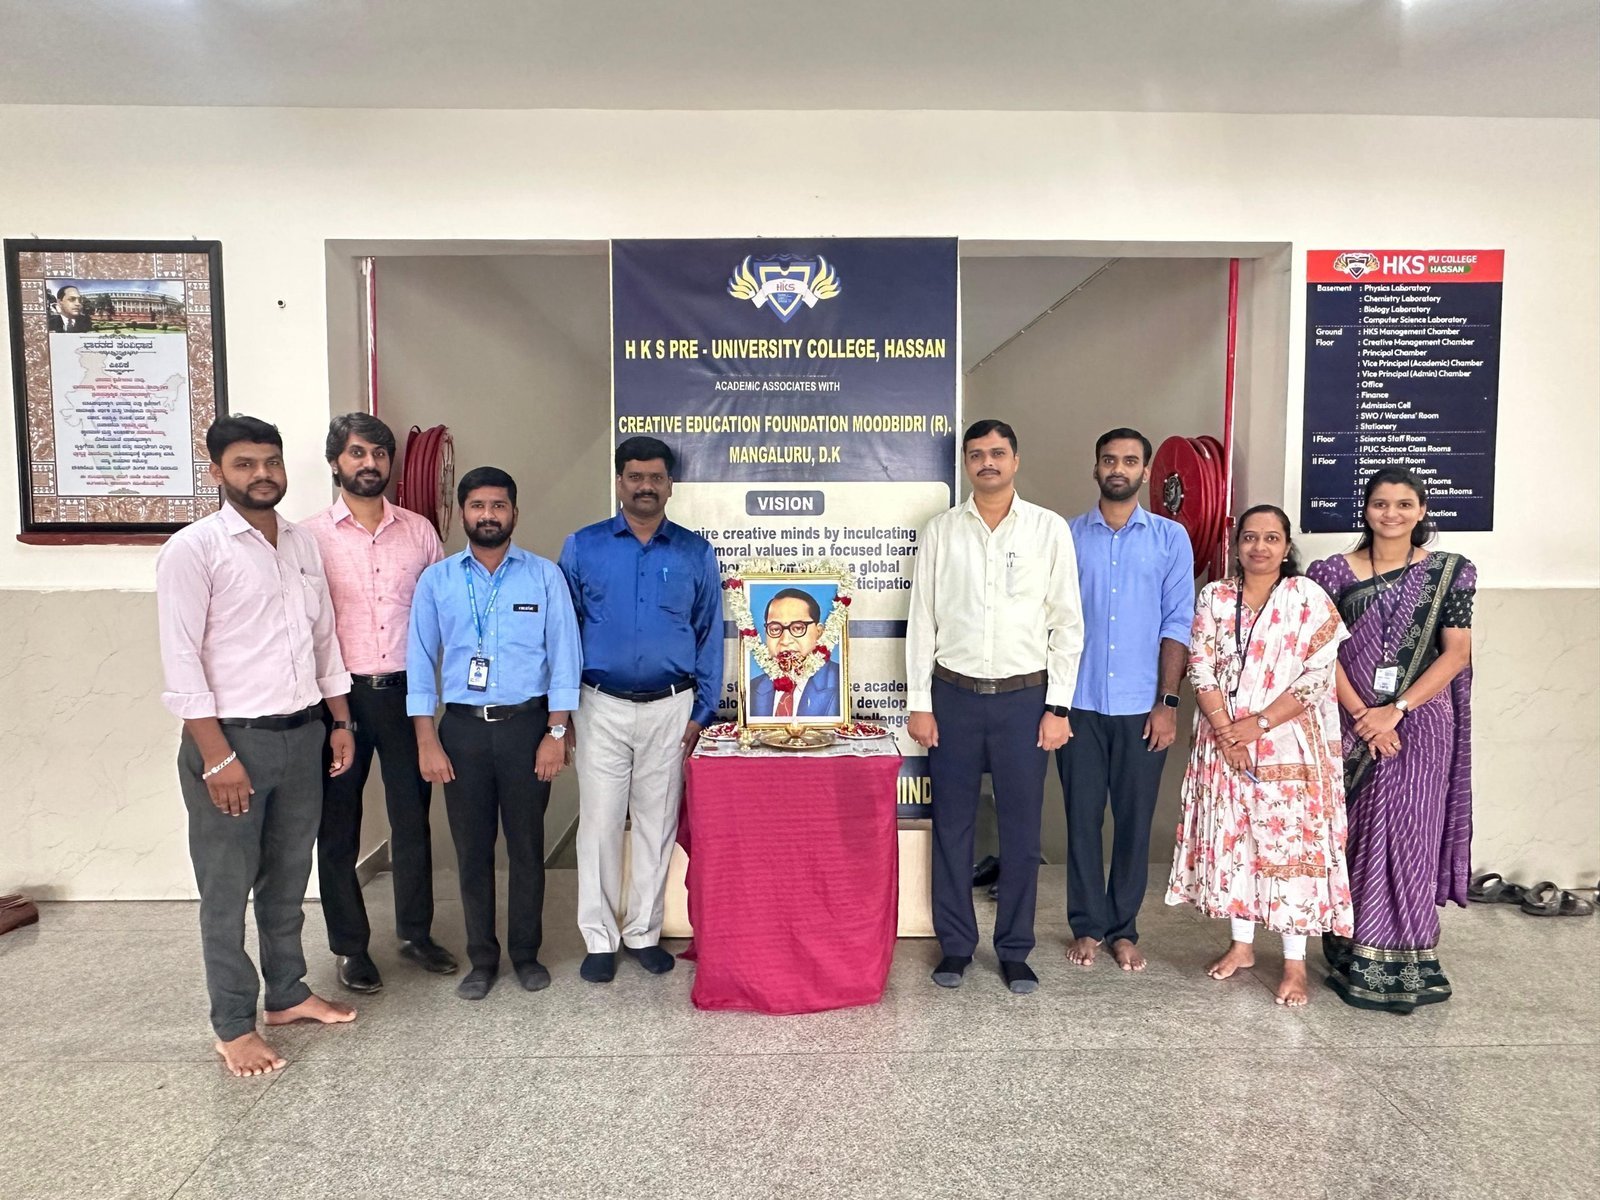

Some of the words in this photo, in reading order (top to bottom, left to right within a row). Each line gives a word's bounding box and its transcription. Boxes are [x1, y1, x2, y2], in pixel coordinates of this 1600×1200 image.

[1383, 255, 1425, 274] HKS
[1428, 255, 1440, 263] PU
[1441, 255, 1477, 263] COLLEGE
[1364, 285, 1390, 293] Physics
[1391, 285, 1431, 293] Laboratory
[1364, 306, 1390, 314] Biology
[1391, 306, 1431, 314] Laboratory
[1379, 328, 1425, 336] Management
[1394, 339, 1440, 347] Management
[670, 340, 698, 359] PRE
[712, 339, 803, 359] UNIVERSITY
[807, 339, 880, 362] COLLEGE,
[885, 338, 945, 357] HASSAN
[1362, 349, 1393, 357] Principal
[1379, 360, 1409, 368] Principal
[1410, 360, 1450, 368] (Academic)
[1378, 370, 1409, 379] Principal
[1410, 370, 1438, 379] (Admin)
[715, 381, 760, 391] ACADEMIC
[762, 381, 816, 391] ASSOCIATES
[819, 381, 840, 391] WITH
[619, 416, 682, 433] CREATIVE
[686, 416, 760, 433] EDUCATION
[765, 416, 848, 432] FOUNDATION
[853, 415, 927, 432] MOODBIDRI
[1360, 423, 1397, 431] Stationery
[729, 446, 815, 466] MANGALURU,
[819, 446, 841, 463] D.K
[757, 497, 813, 510] VISION
[723, 527, 776, 540] creative
[781, 527, 820, 540] minds
[824, 527, 839, 542] by
[843, 526, 917, 542] inculcating
[714, 543, 751, 556] moral
[755, 544, 798, 556] values
[802, 543, 814, 556] in
[818, 547, 826, 556] a
[829, 543, 882, 556] focused
[860, 560, 900, 576] global
[857, 577, 913, 592] ticipatio
[897, 776, 932, 804] IND
